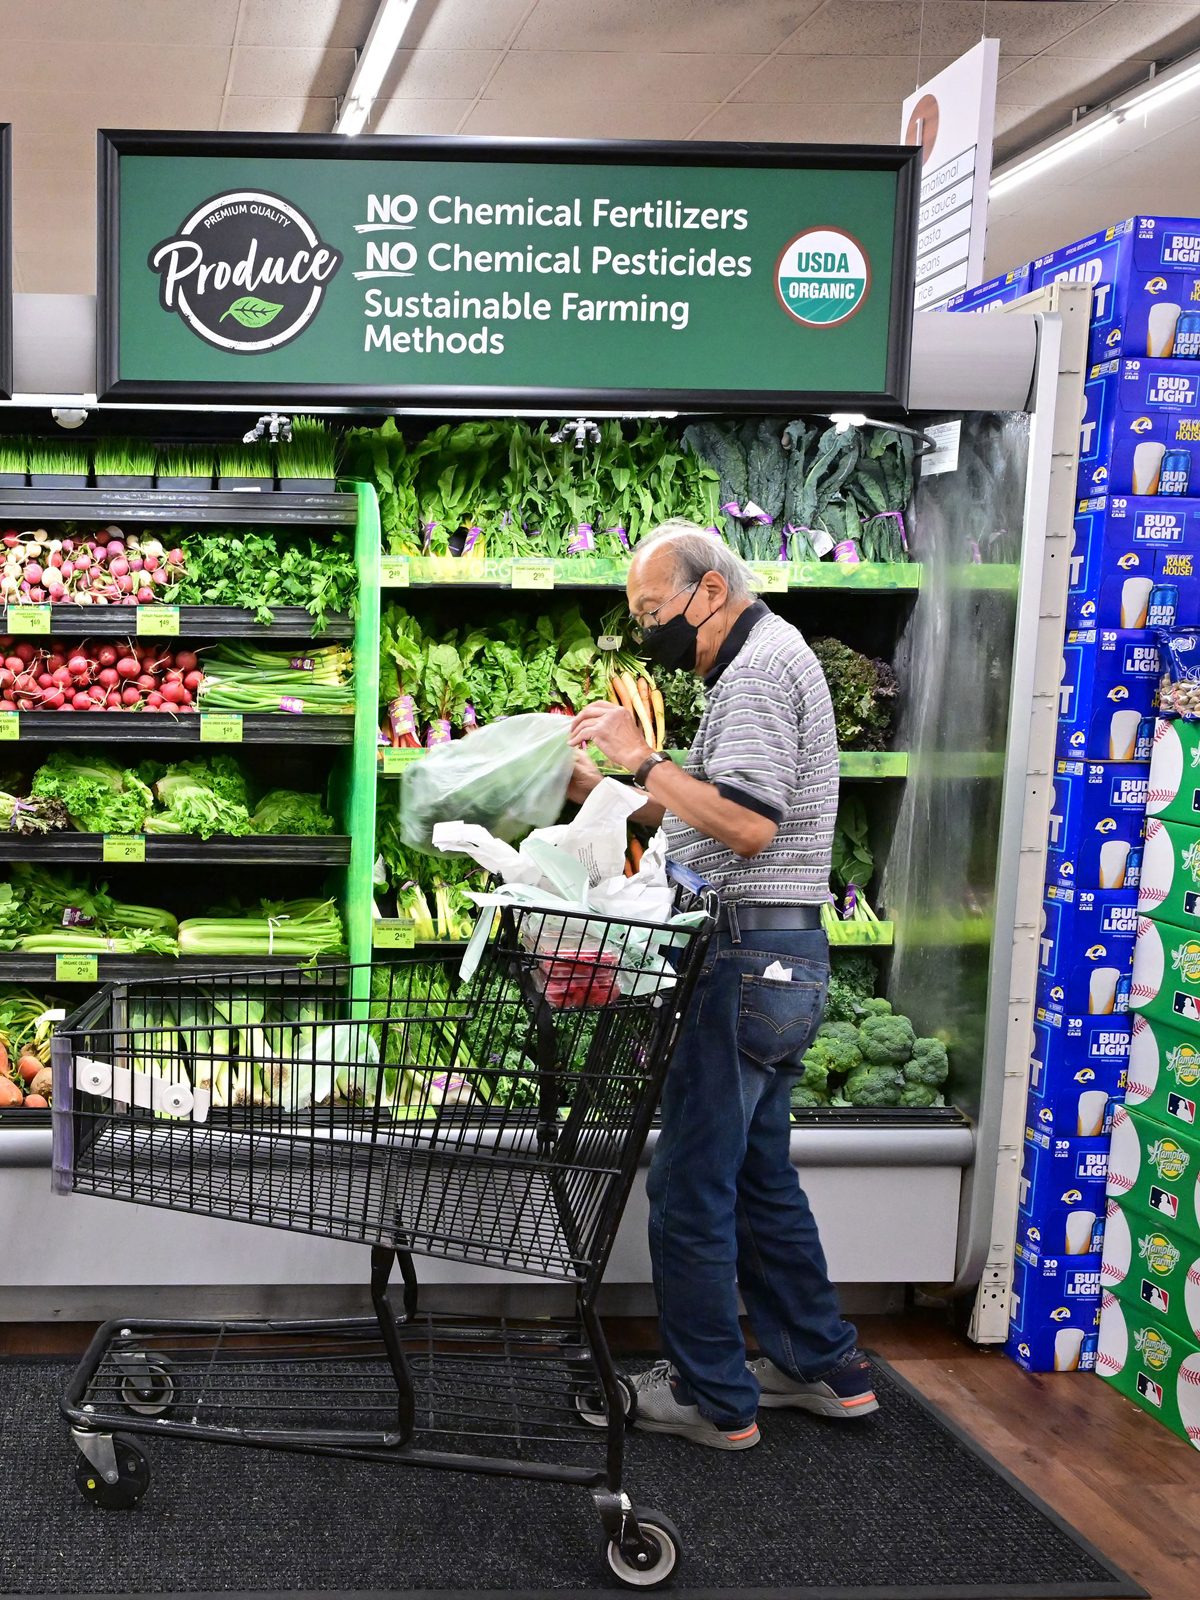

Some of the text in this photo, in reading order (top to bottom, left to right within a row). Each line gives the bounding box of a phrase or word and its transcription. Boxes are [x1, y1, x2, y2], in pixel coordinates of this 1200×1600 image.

[930, 193, 957, 217] sauce
[203, 204, 291, 229] PREMIUM QUALITY
[367, 194, 748, 230] NO Chemical Fertilizers
[1140, 219, 1155, 229] 30
[366, 241, 752, 278] NO Chemical Pesticides
[797, 251, 850, 273] USDA
[1164, 249, 1200, 263] LIGH
[153, 238, 337, 306] Produce
[788, 281, 855, 300] ORGANIC
[917, 284, 934, 302] rice
[364, 288, 689, 330] Sustainable Farming
[364, 324, 504, 354] Methods
[1172, 343, 1200, 355] LIGH
[1125, 361, 1140, 370] 30
[1157, 377, 1189, 390] BUD
[1149, 389, 1195, 404] LIGHT
[1162, 471, 1187, 482] BUD
[1158, 481, 1188, 493] LIGHT
[1112, 499, 1127, 508] 30
[1144, 514, 1176, 528] BUD
[1136, 526, 1181, 540] LIGHT
[1166, 557, 1191, 567] RAMS
[1162, 566, 1193, 576] HOUSE!
[1150, 605, 1174, 616] BUD
[159, 620, 170, 628] 149
[1145, 616, 1176, 627] LIGHT
[1102, 632, 1117, 641] 30
[1126, 659, 1160, 672] LIGH
[1134, 747, 1153, 757] LIG
[1089, 765, 1104, 774] 30
[1113, 791, 1148, 804] LIGH
[125, 847, 137, 855] 229
[1123, 876, 1140, 887] LIG
[1080, 893, 1094, 902] 30
[1103, 919, 1137, 931] LIGH
[394, 933, 406, 941] 249
[1113, 1002, 1129, 1012] LIG
[1068, 1019, 1082, 1028] 30
[1099, 1033, 1130, 1044] BUD
[1055, 1140, 1070, 1149] 30
[1147, 1140, 1191, 1167] Hampton
[1085, 1154, 1108, 1166] BU
[1079, 1165, 1108, 1177] LIGH
[1158, 1159, 1186, 1179] Farms
[1138, 1234, 1180, 1261] Hampton
[1043, 1259, 1058, 1268] 30
[1148, 1254, 1176, 1273] Farms
[1067, 1284, 1101, 1295] LIGH
[1134, 1328, 1172, 1356] Hampton
[1143, 1347, 1169, 1369] Farms
